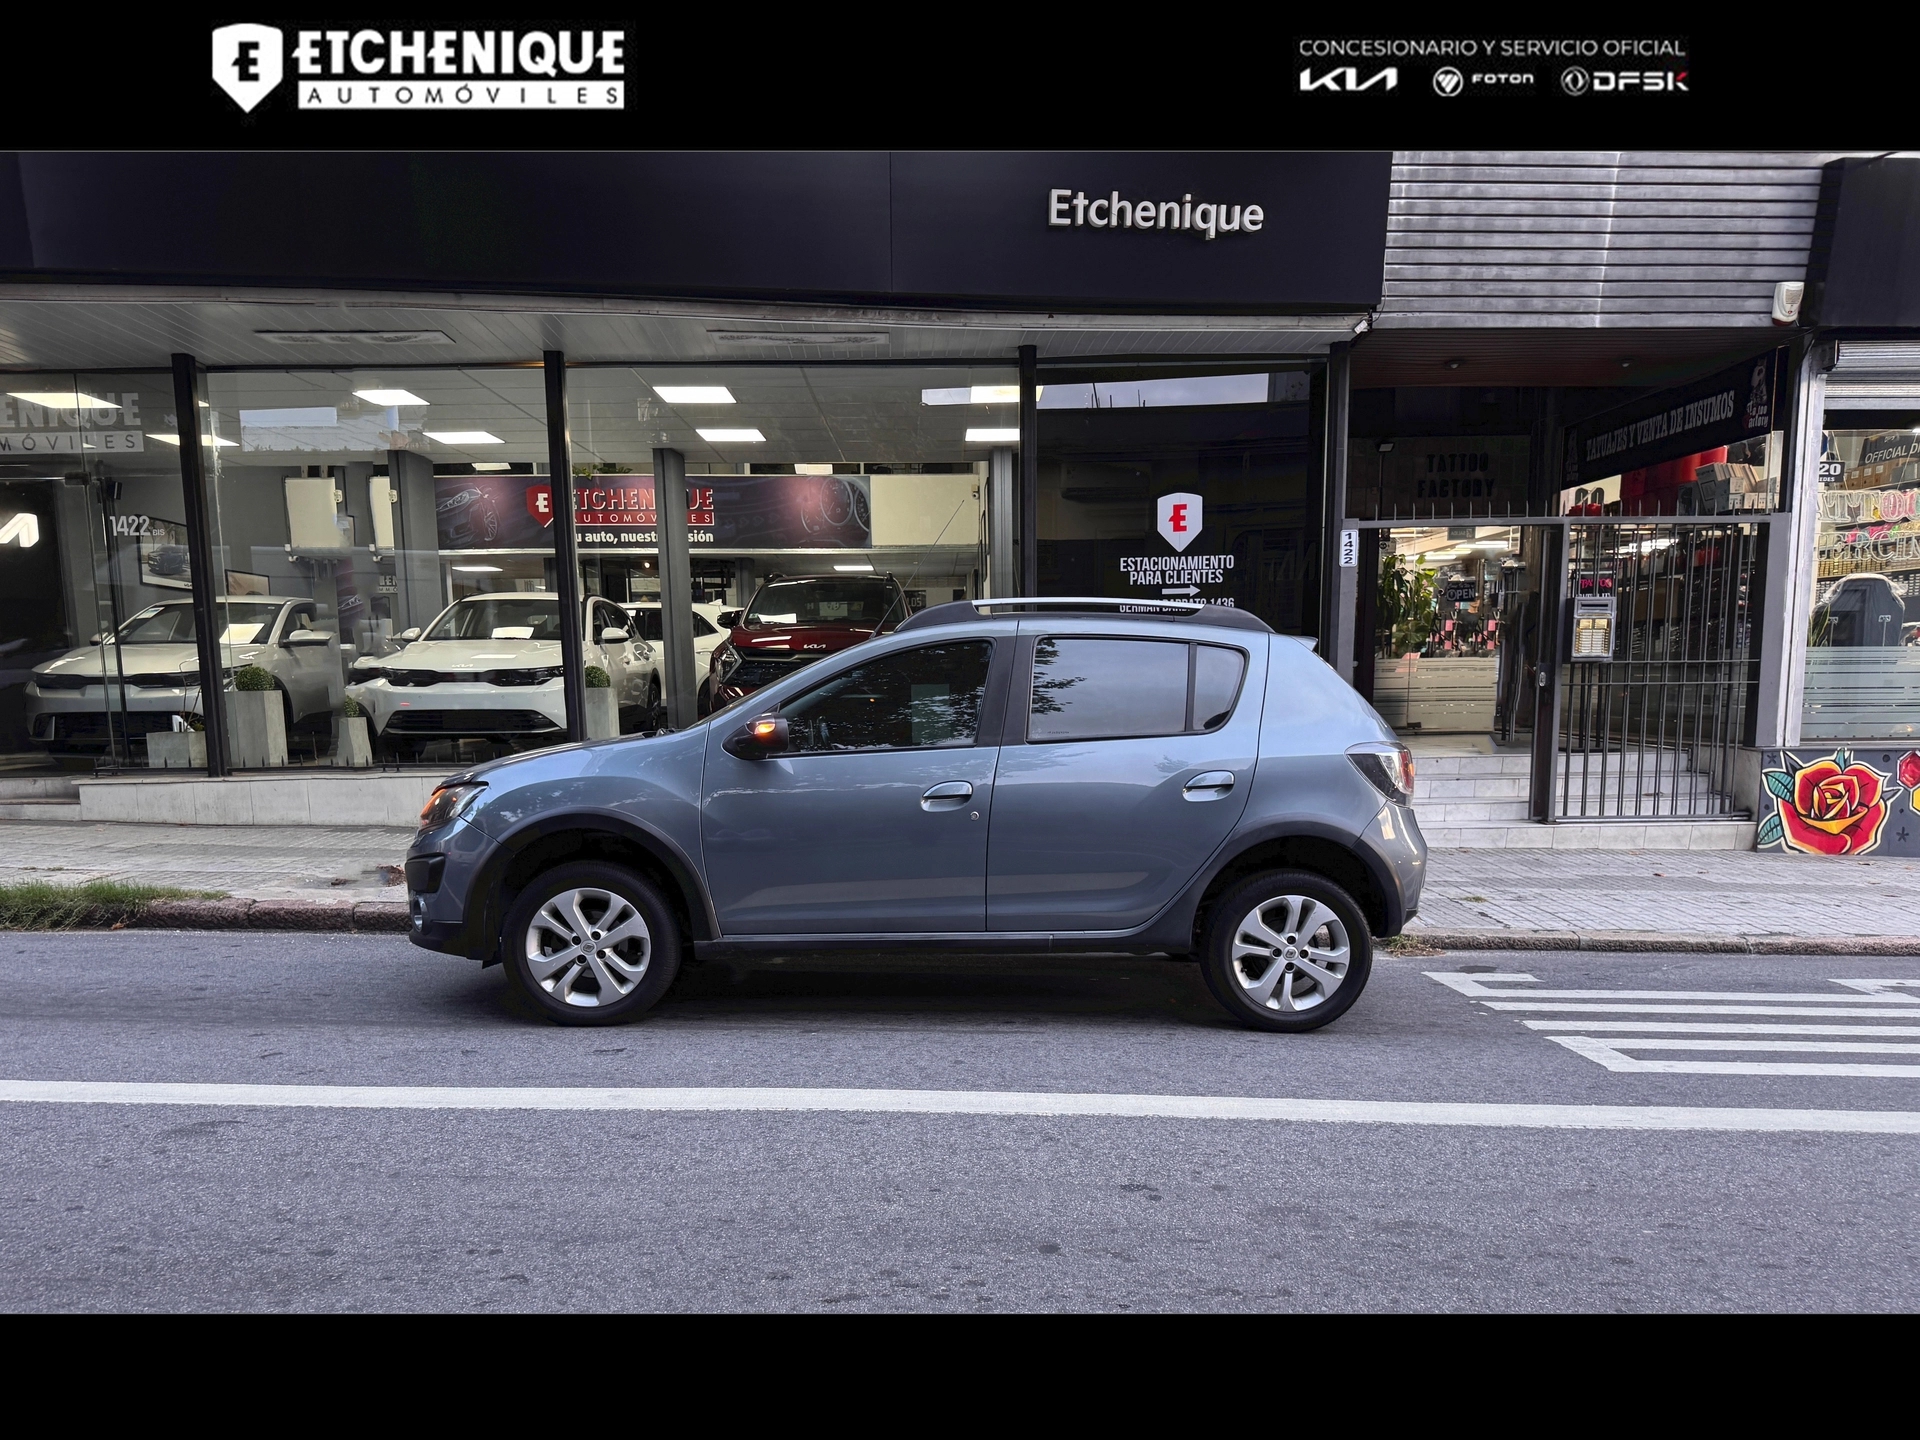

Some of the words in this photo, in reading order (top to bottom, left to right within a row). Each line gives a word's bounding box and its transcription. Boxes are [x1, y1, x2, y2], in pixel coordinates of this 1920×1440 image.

[1049, 188, 1264, 240] Etchenique
[1586, 427, 1628, 462] TATUAJES
[1629, 422, 1637, 447] Y
[1637, 411, 1669, 446] VENTA
[1669, 406, 1684, 435] DE
[1684, 389, 1735, 430] INSUMOS
[1426, 452, 1489, 473] TATTOO
[1865, 444, 1908, 464] OFFICIAL
[1417, 478, 1495, 498] FACTORY
[572, 488, 714, 510] TCHENUE
[110, 515, 151, 537] 1422
[574, 512, 711, 522] UTOMÓVES
[585, 531, 618, 544] auto,
[621, 531, 658, 542] nuest
[687, 530, 714, 542] sión
[1343, 532, 1354, 565] 1422
[1119, 555, 1235, 572] ESTACIONAMIENTO
[1129, 571, 1162, 585] PARA
[1165, 569, 1224, 585] CLIENTES
[1446, 588, 1475, 601] OPEN
